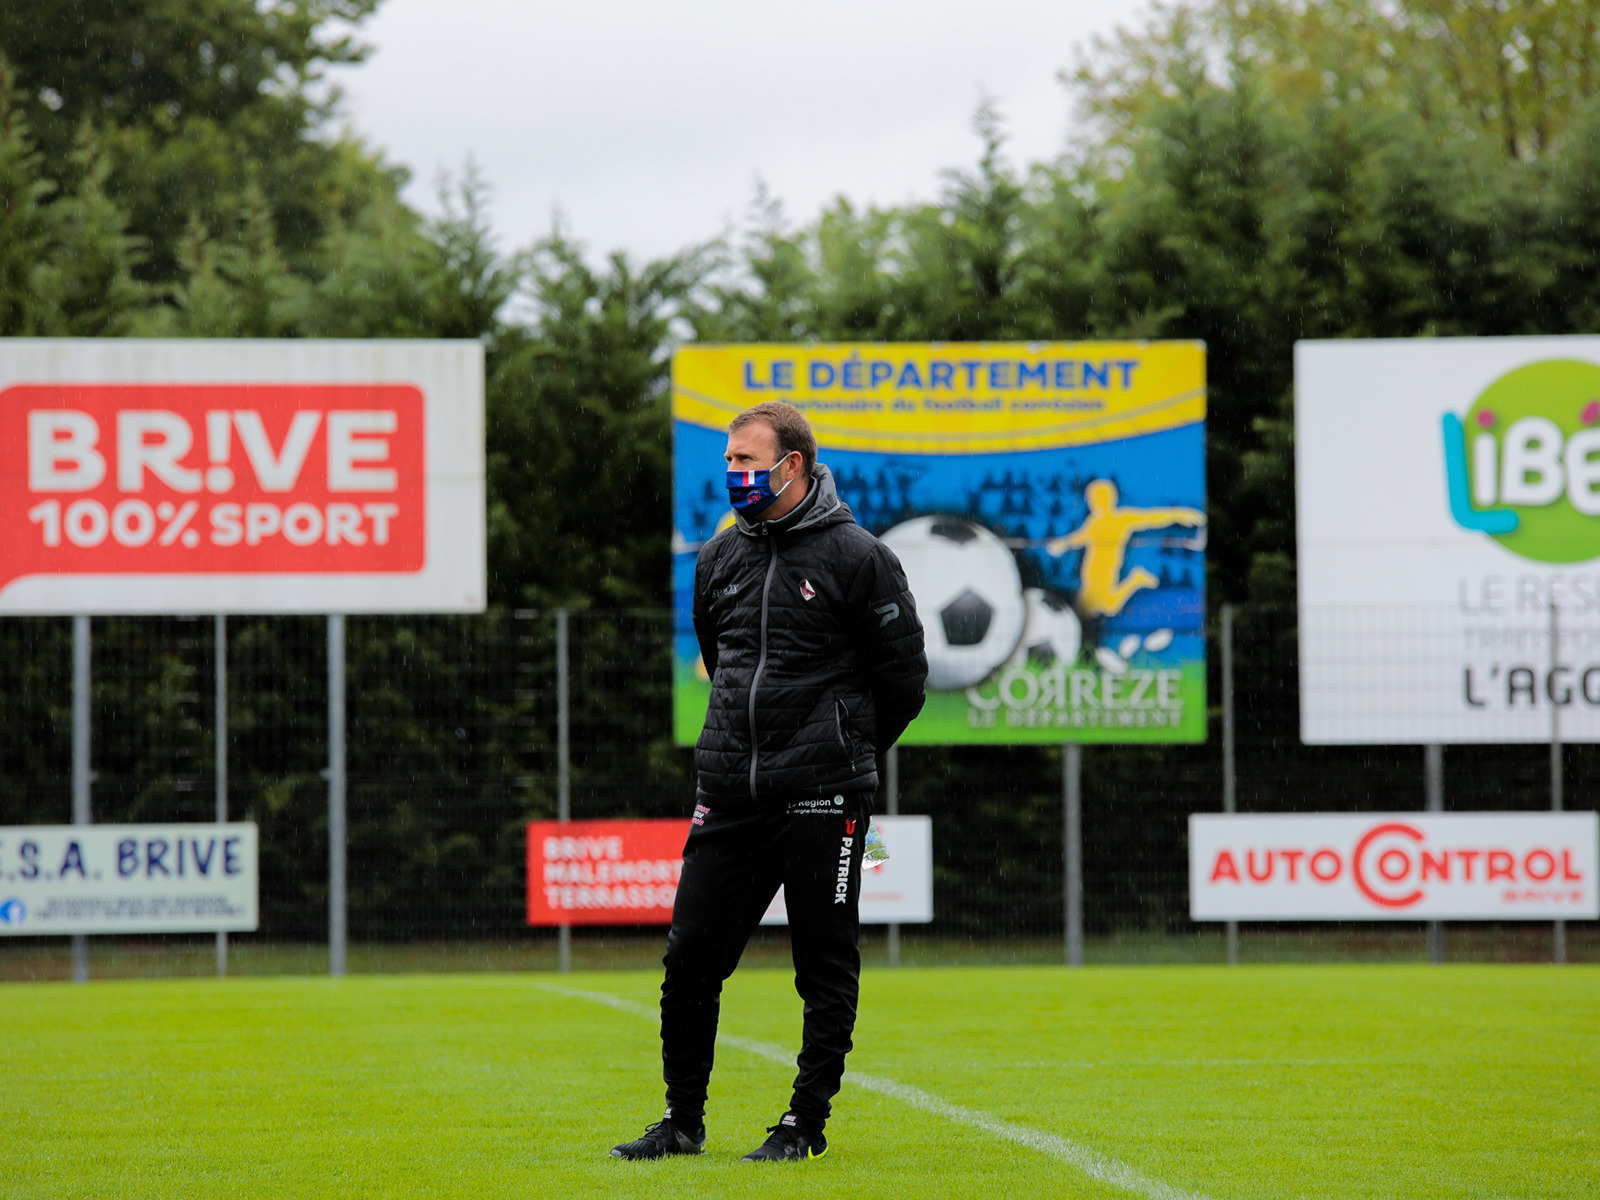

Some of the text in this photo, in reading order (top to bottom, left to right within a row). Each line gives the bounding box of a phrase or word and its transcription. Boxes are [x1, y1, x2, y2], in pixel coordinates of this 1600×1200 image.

[743, 353, 1139, 390] LE DÉPARTEMENT
[27, 499, 398, 547] 100% SPORT
[1458, 574, 1600, 615] LE RES
[0, 836, 242, 882] .S.A. BRIVE
[543, 836, 623, 860] BRIVE
[834, 836, 853, 904] PATRICK
